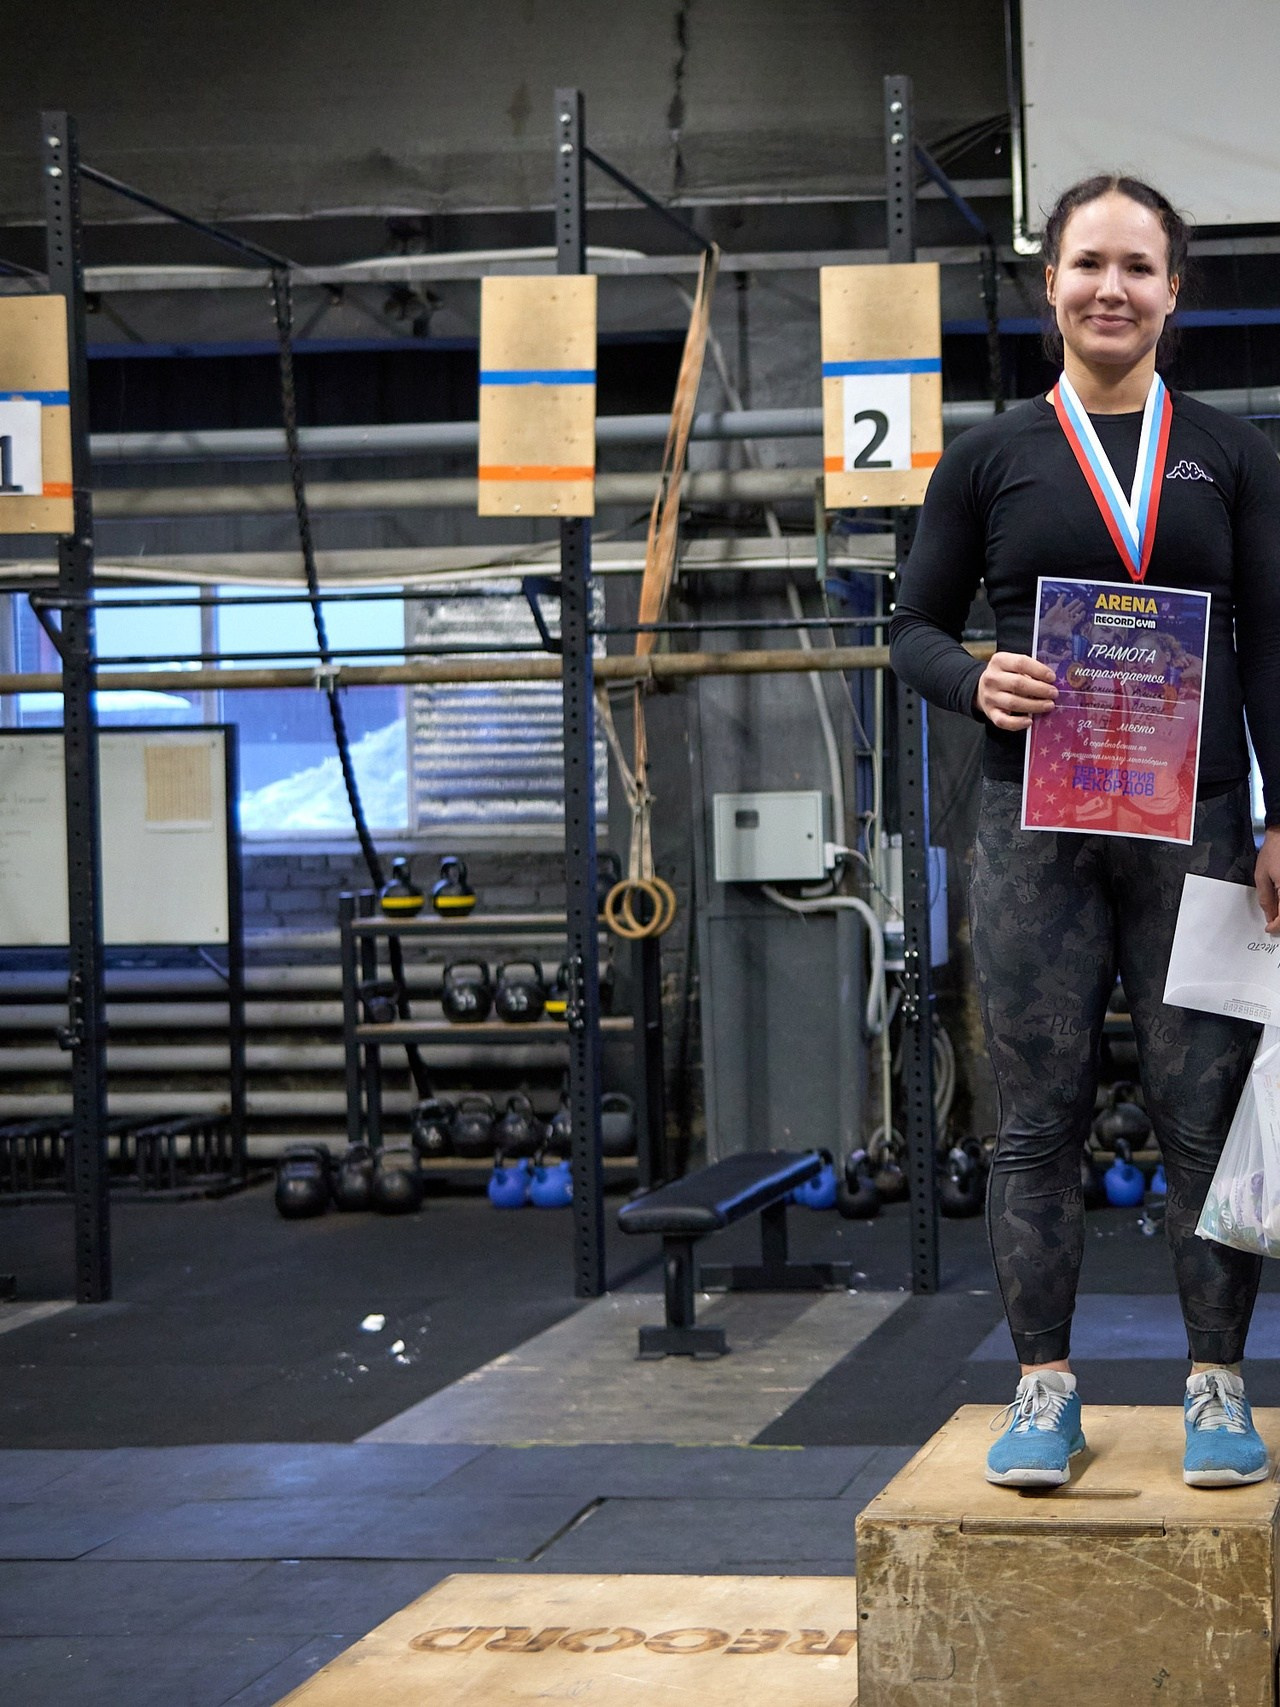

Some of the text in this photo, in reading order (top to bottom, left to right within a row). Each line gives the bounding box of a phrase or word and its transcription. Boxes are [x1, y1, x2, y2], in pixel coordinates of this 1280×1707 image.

[853, 409, 892, 469] 2
[0, 435, 23, 492] 1
[1095, 593, 1158, 615] ARENA
[1095, 614, 1156, 629] RECORD GYM
[1087, 644, 1157, 664] ГРАМОТА
[1074, 666, 1166, 685] награждается
[1077, 719, 1092, 733] за
[1116, 722, 1156, 735] место
[1072, 764, 1156, 783] ТЕРРИТОРИЯ
[1072, 777, 1155, 797] РЕКОРДОВ
[408, 1625, 857, 1656] RECORD
